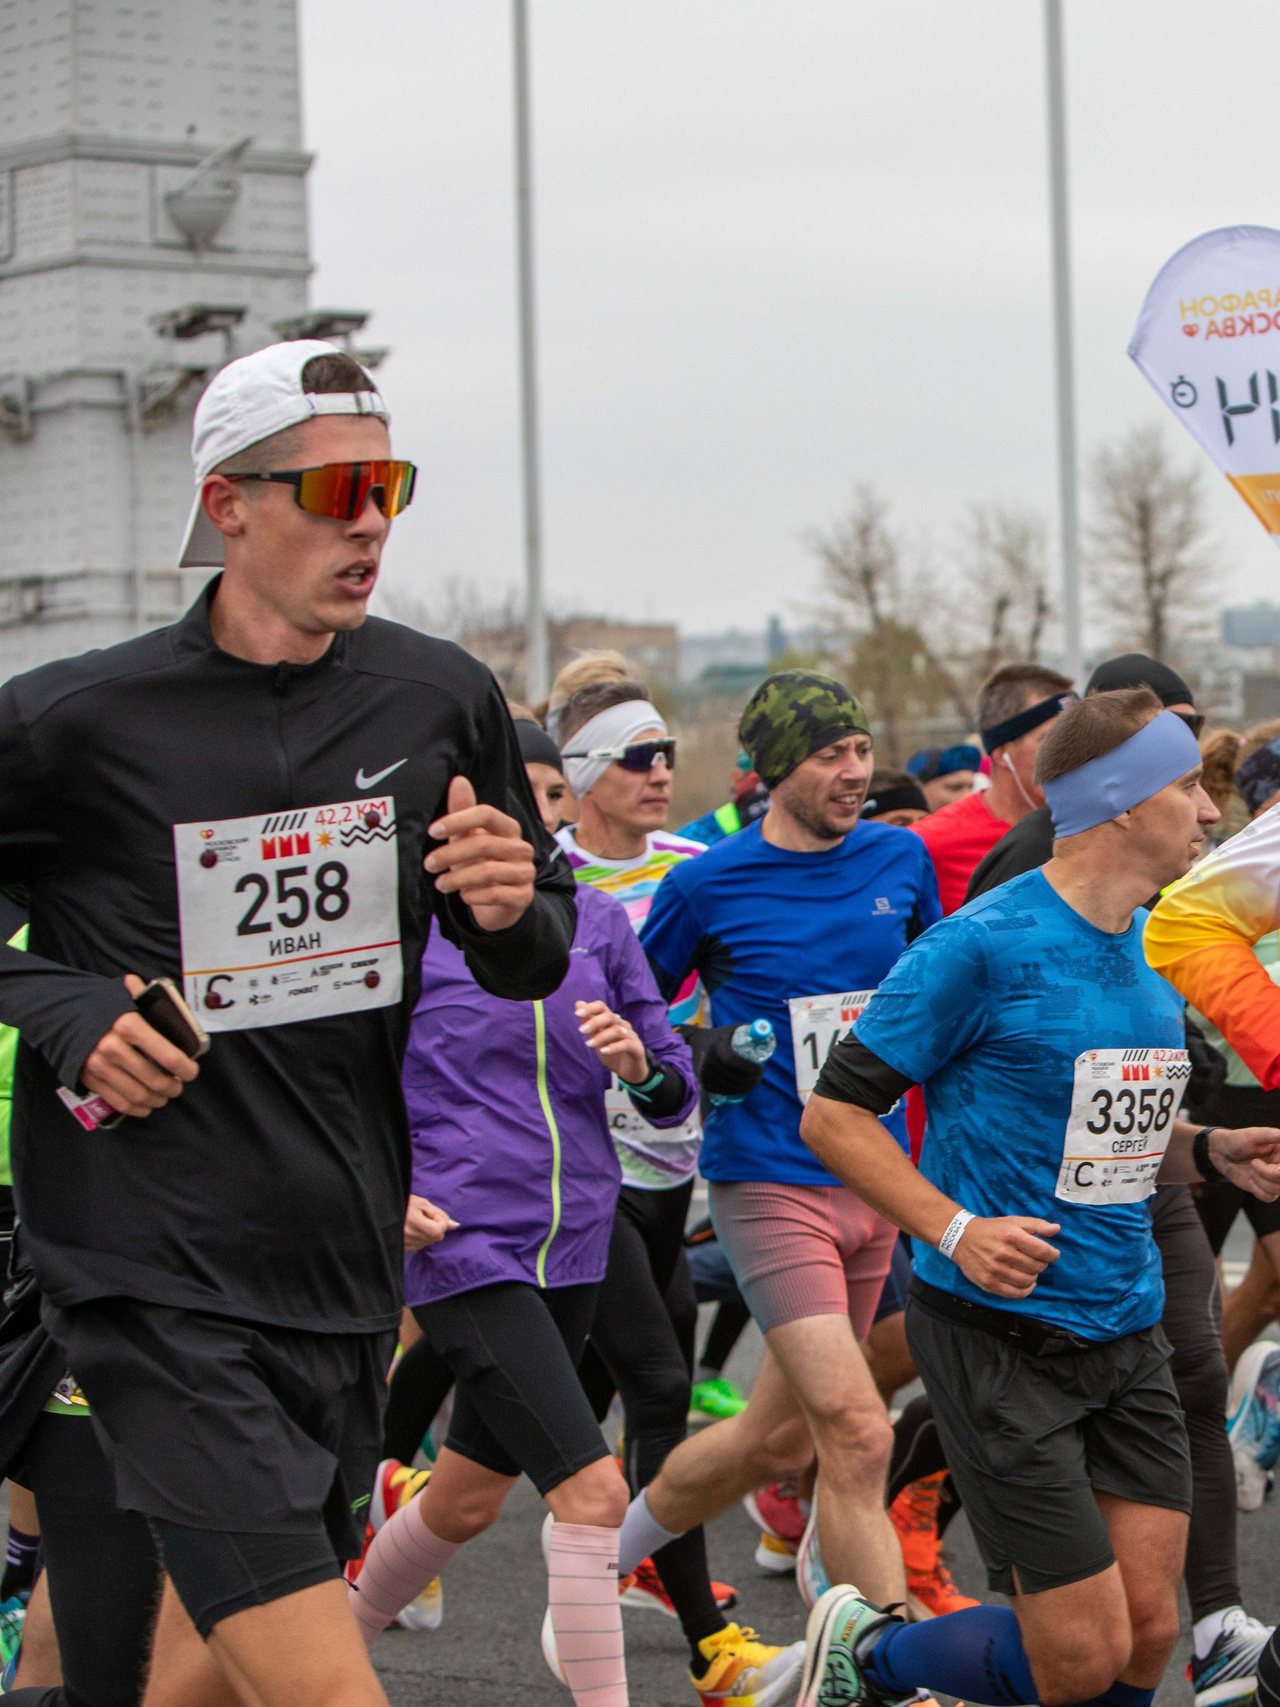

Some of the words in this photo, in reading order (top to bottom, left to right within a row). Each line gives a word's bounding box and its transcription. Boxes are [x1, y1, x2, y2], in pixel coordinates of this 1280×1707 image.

[314, 805, 353, 826] 42,2
[234, 860, 350, 937] 258
[269, 932, 321, 957] ИВАН
[1086, 1087, 1175, 1135] 3358
[1111, 1136, 1148, 1153] СЕРГЕЙ
